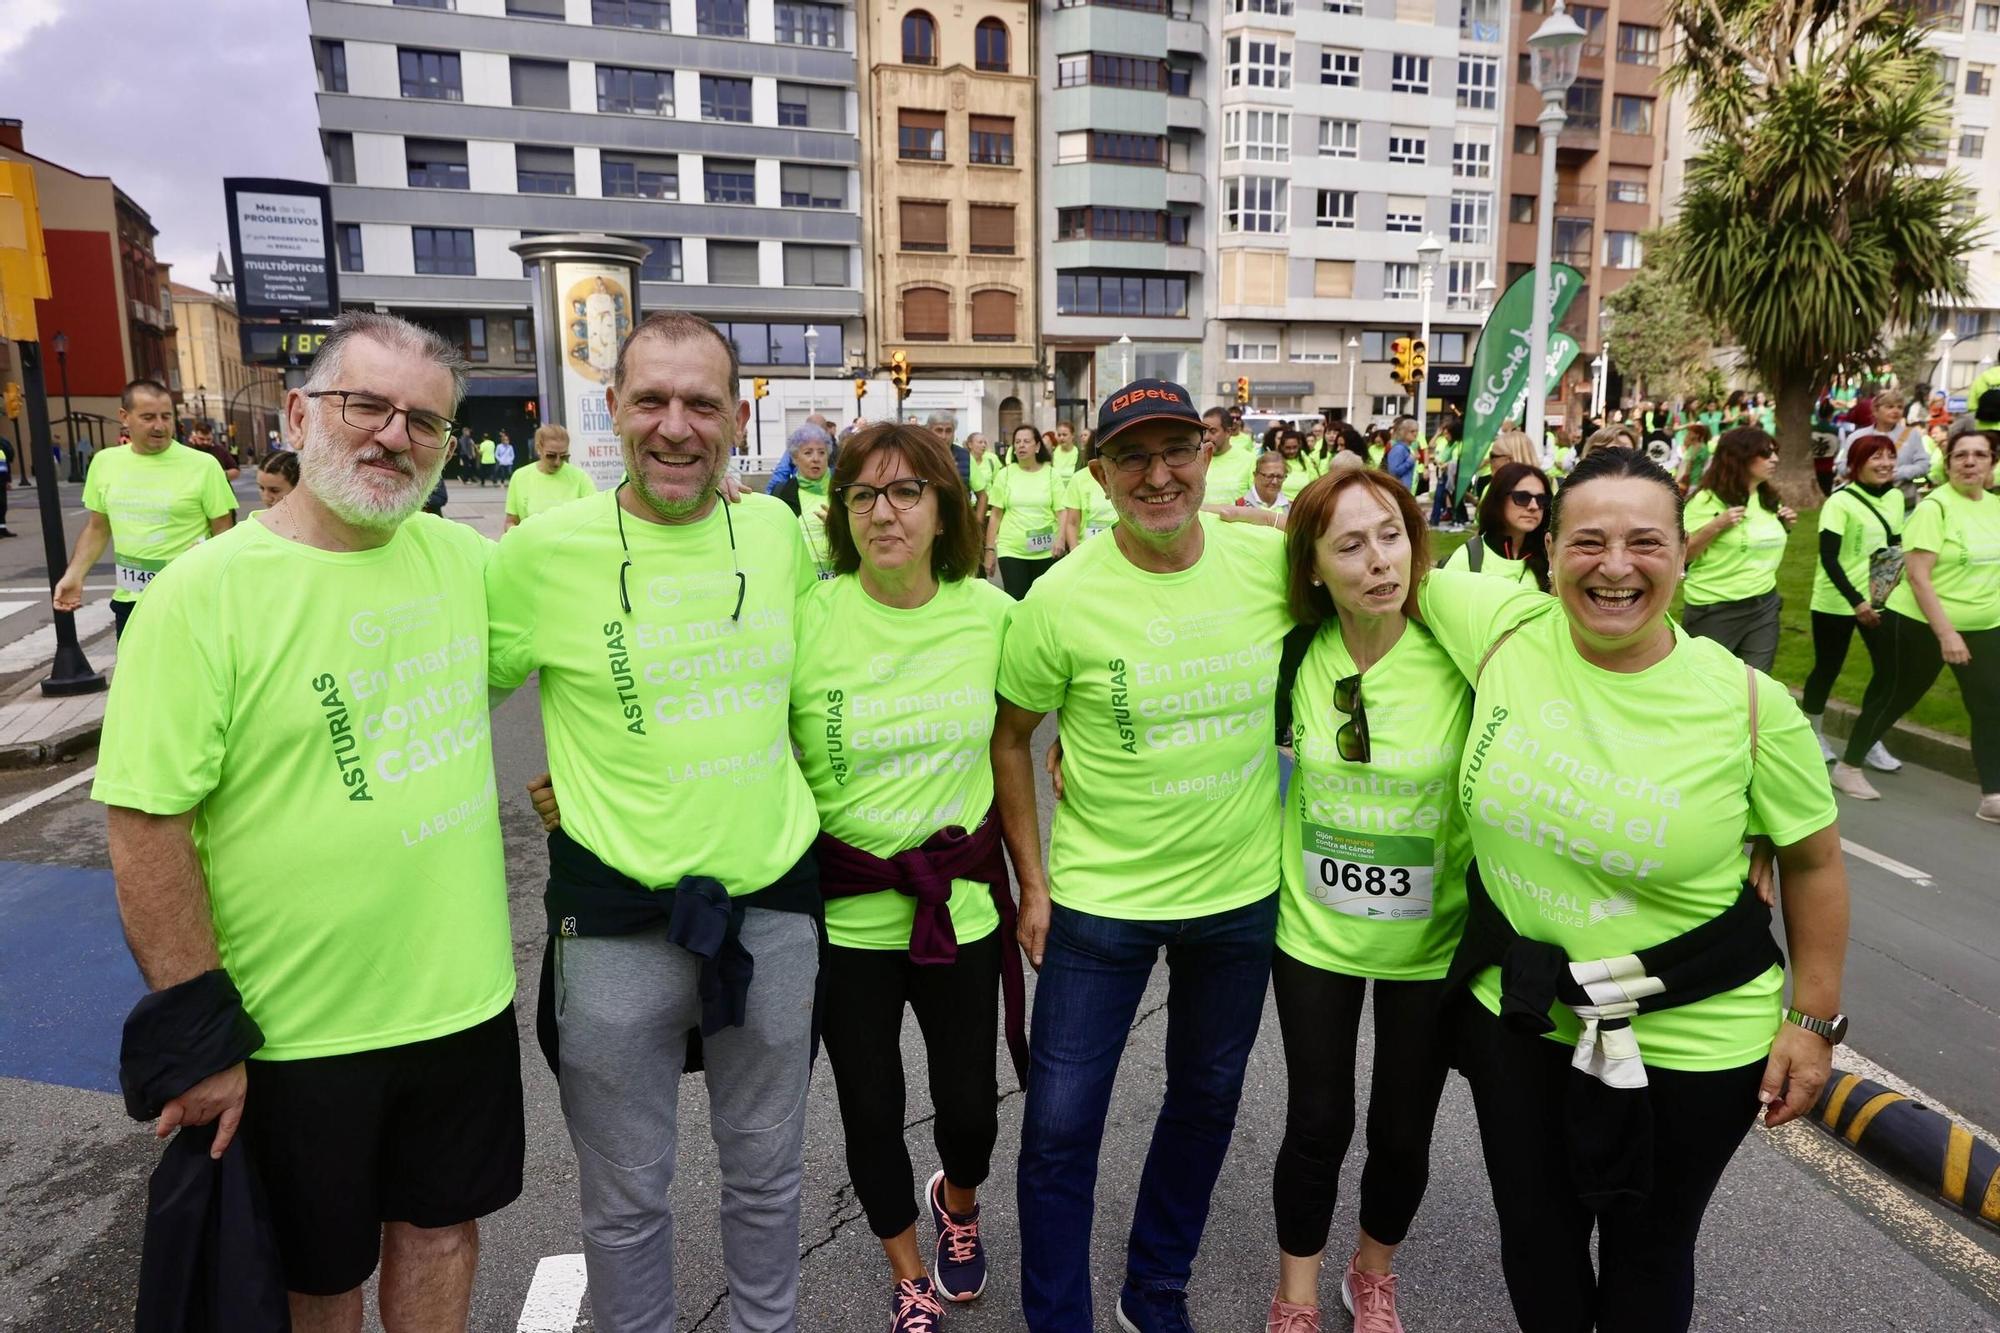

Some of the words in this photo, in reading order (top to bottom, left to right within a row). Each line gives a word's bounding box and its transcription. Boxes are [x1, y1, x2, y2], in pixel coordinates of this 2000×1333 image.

[244, 213, 318, 226] PROGRESIVOS
[256, 203, 276, 213] Mes
[1130, 388, 1181, 406] Beta
[636, 624, 678, 649] En
[348, 668, 388, 700] En
[603, 620, 646, 736] ASTURIAS
[643, 645, 767, 685] contra
[1135, 662, 1172, 686] En
[364, 679, 473, 740] contra
[852, 695, 887, 718] En
[1109, 658, 1137, 755] ASTURIAS
[1138, 680, 1253, 717] contra
[312, 673, 374, 801] ASTURIAS
[826, 689, 848, 786] ASTURIAS
[851, 719, 963, 750] contra
[1145, 706, 1265, 750] cánce
[1462, 705, 1509, 818] ASTURIAS
[1502, 722, 1541, 760] En
[1544, 750, 1681, 810] marcha
[1306, 772, 1418, 797] contra
[1487, 761, 1616, 833] contra
[1624, 814, 1669, 849] el
[1315, 830, 1333, 841] Gijón
[1315, 838, 1339, 849] contra
[1348, 845, 1375, 855] cáncer
[1479, 796, 1664, 881] cáncer
[1320, 857, 1412, 897] 0683
[1488, 856, 1585, 914] LABORAL
[1539, 905, 1584, 928] kutxa
